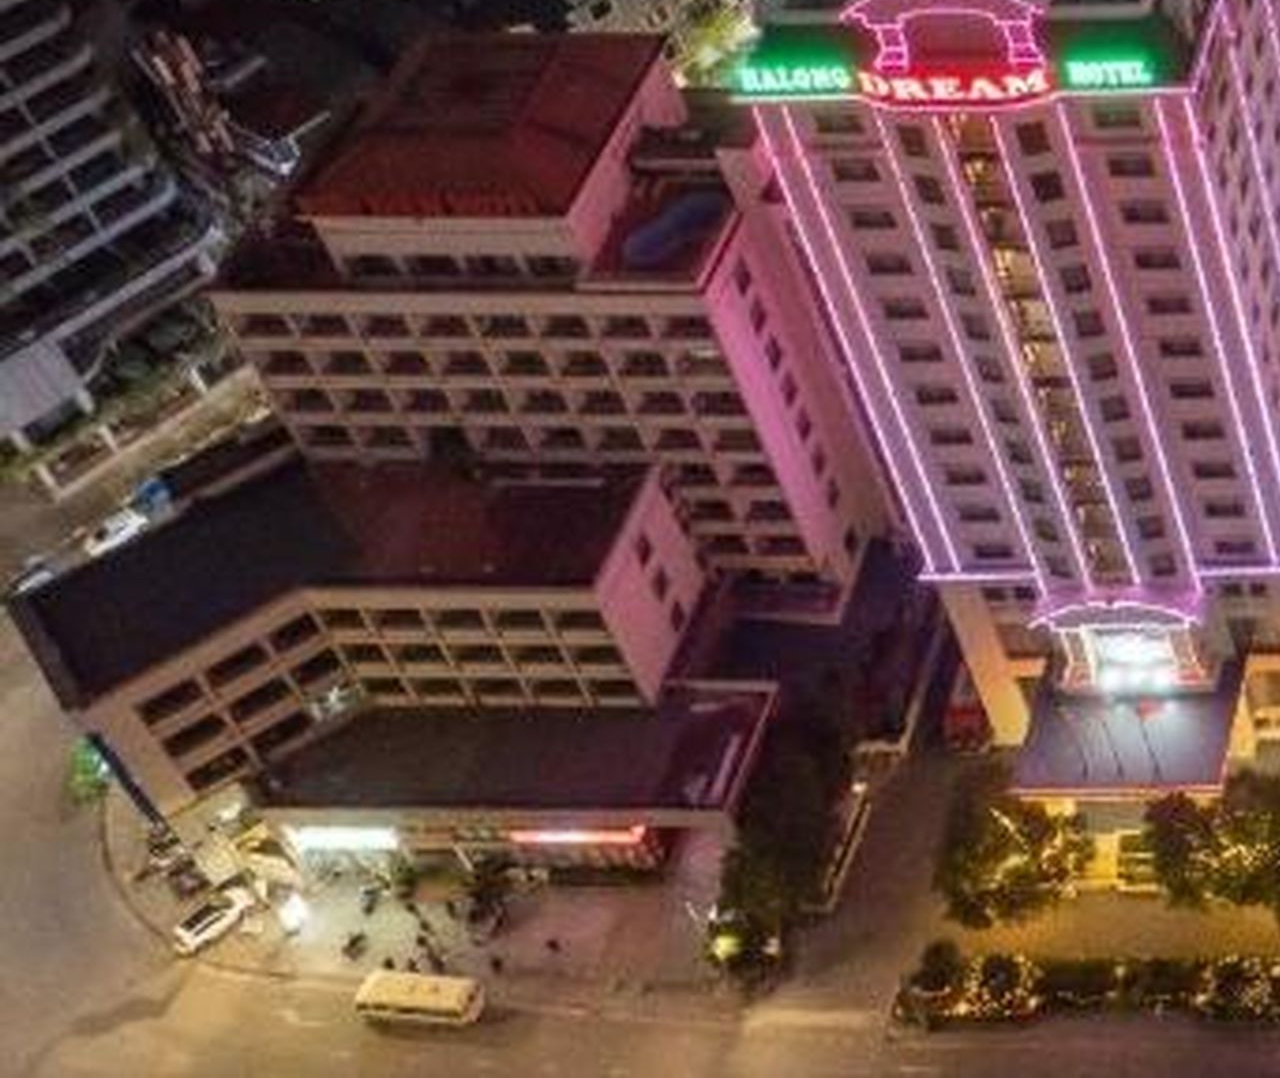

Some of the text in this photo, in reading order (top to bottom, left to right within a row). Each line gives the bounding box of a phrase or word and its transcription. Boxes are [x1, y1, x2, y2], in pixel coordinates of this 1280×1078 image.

[740, 60, 1153, 100] HALONG DREAM HOTEL
